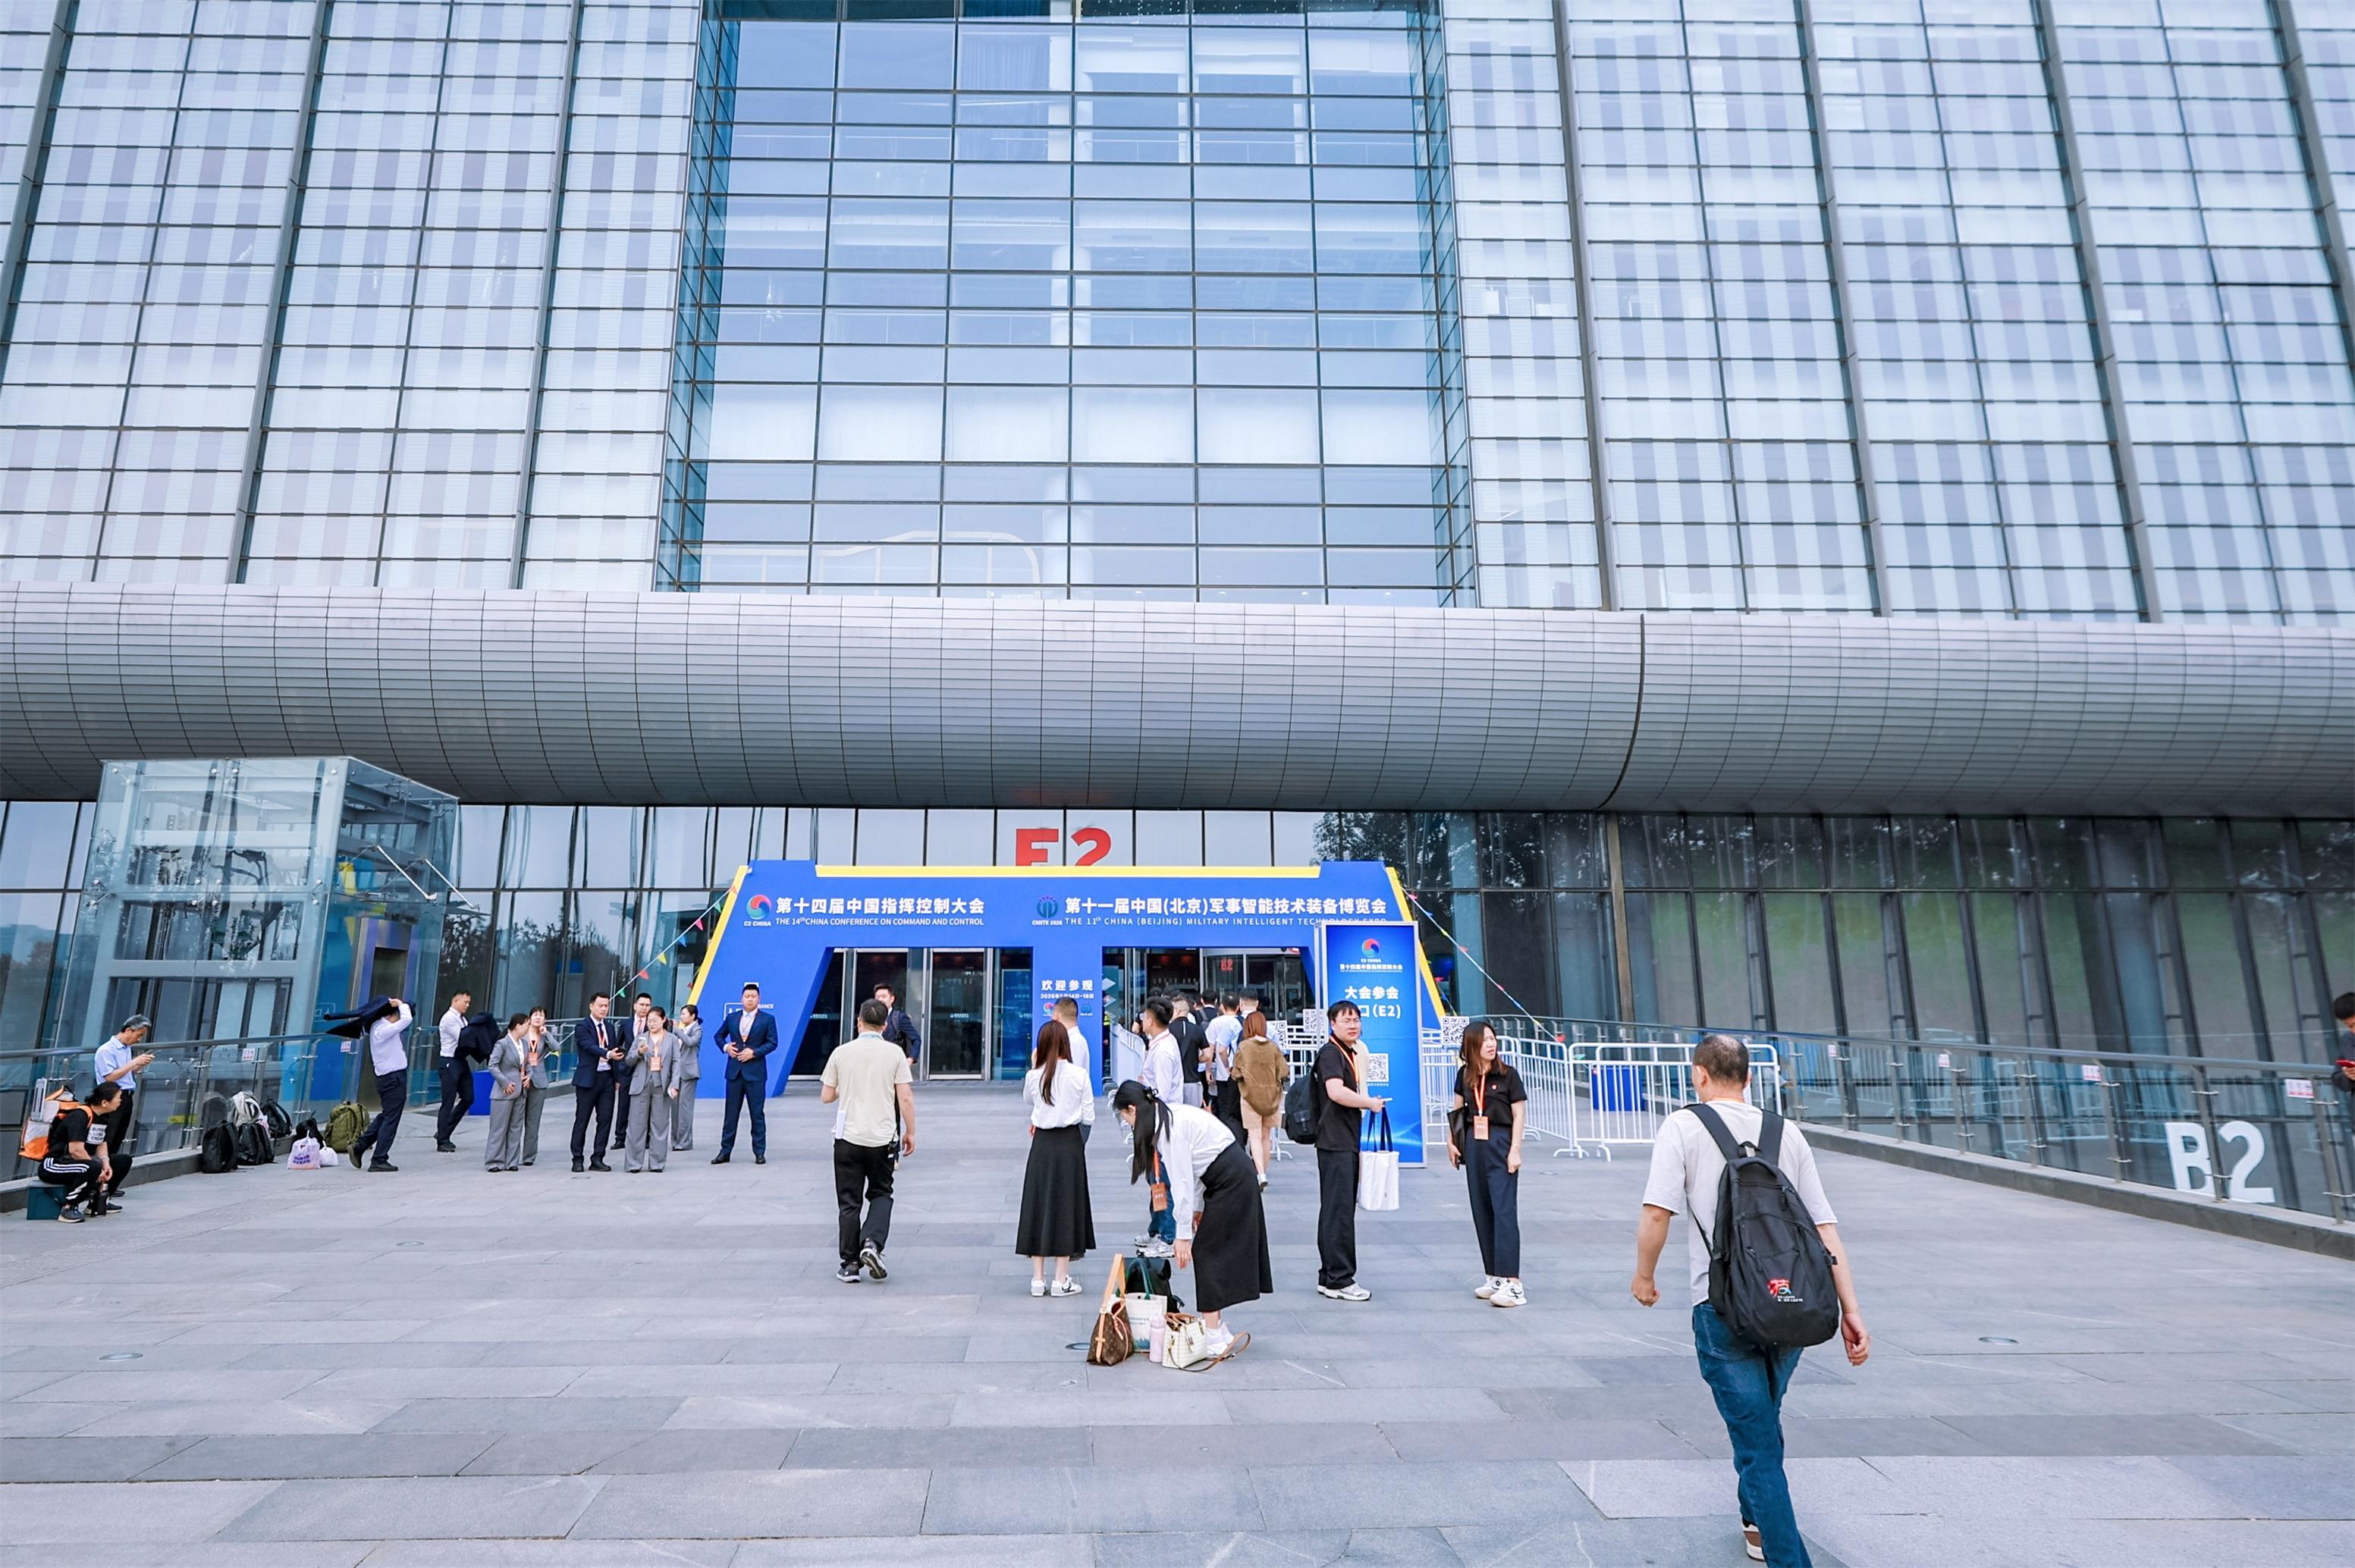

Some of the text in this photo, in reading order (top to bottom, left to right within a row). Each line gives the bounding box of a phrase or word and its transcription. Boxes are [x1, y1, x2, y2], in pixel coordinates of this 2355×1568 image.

[776, 897, 984, 914] 第十四届中国指挥控制大会
[1065, 897, 1386, 916] 第十一届中国(北京)军事智能技术装备博览会
[1087, 917, 1101, 925] 11th
[1138, 917, 1182, 926] (BEIJING)
[1041, 979, 1093, 991] 欢迎参观
[1344, 985, 1399, 999] 大会参会
[1359, 1003, 1401, 1019] 口(E2)
[2164, 1121, 2275, 1203] B2
